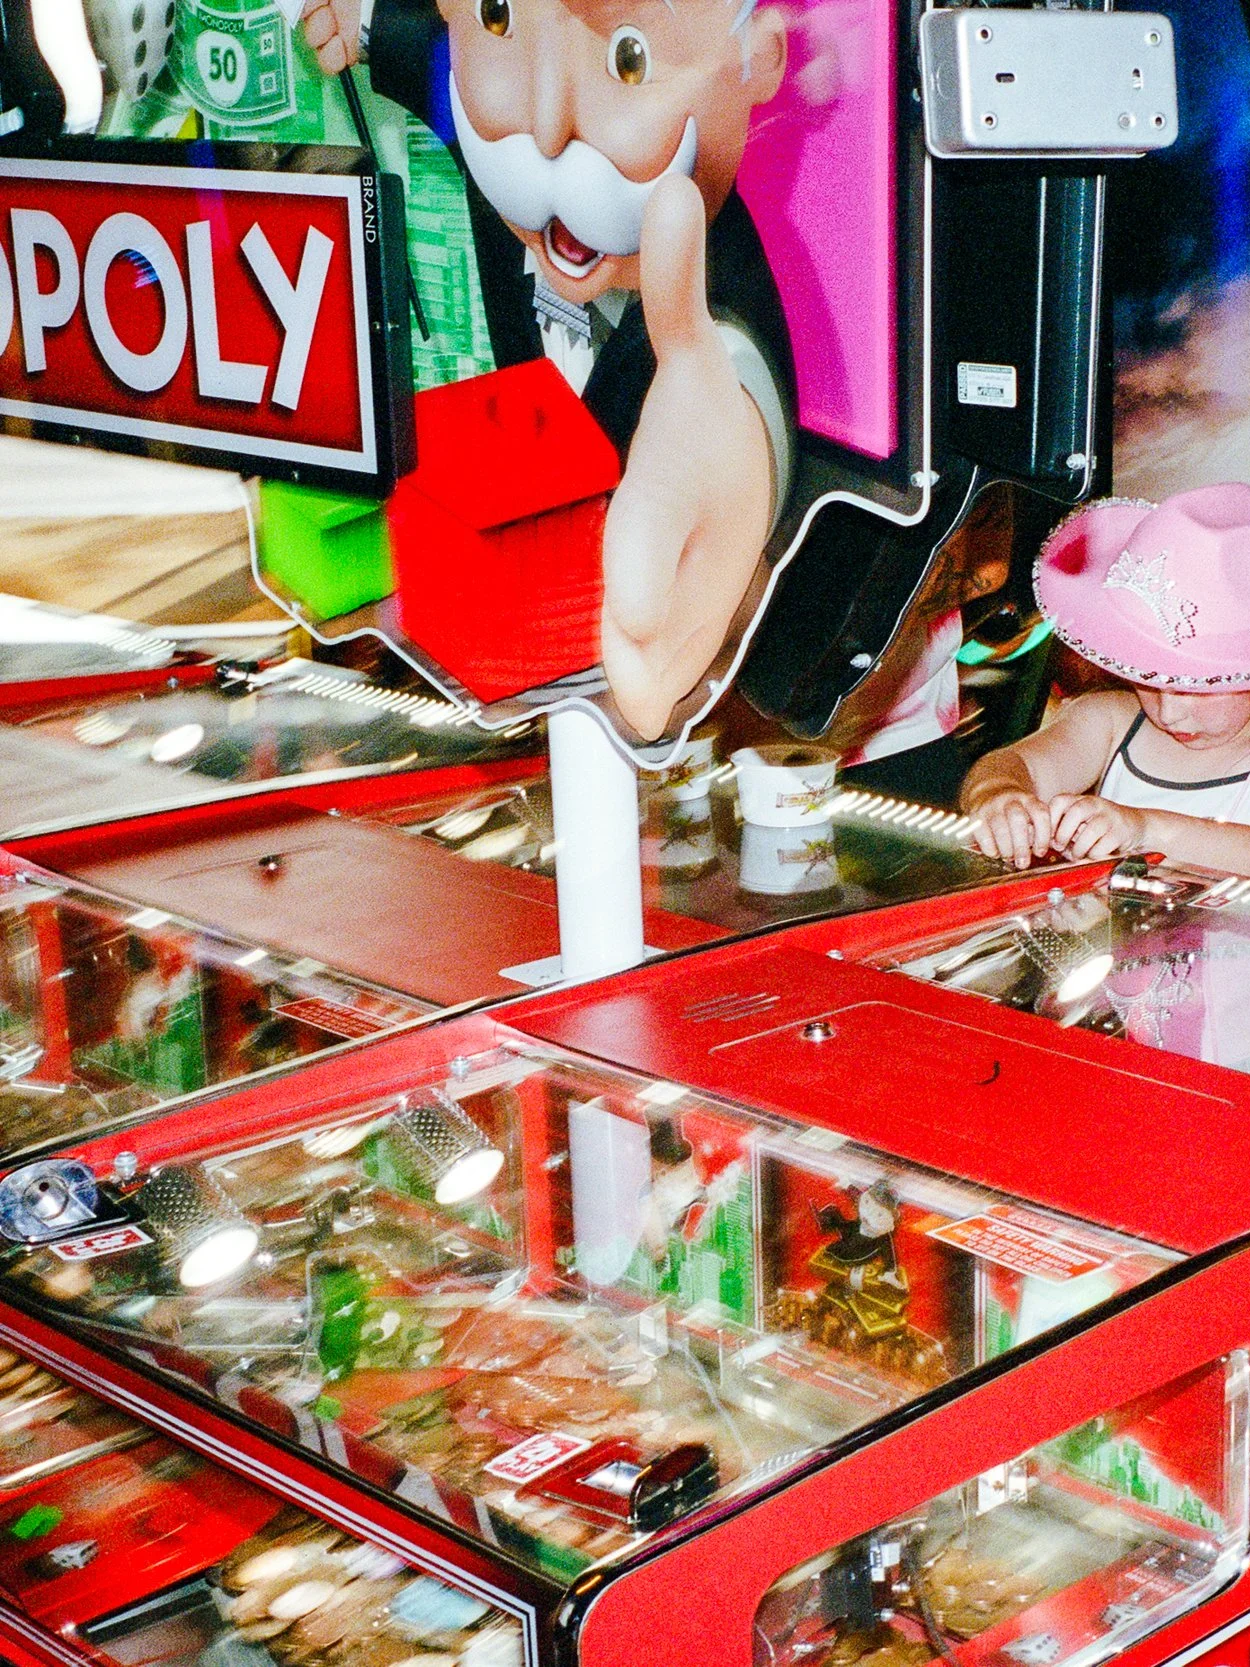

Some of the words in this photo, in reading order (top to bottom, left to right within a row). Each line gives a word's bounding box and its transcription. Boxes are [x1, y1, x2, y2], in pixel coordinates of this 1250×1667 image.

[209, 46, 237, 83] 50
[362, 176, 376, 243] BRAND
[0, 208, 335, 411] POLY
